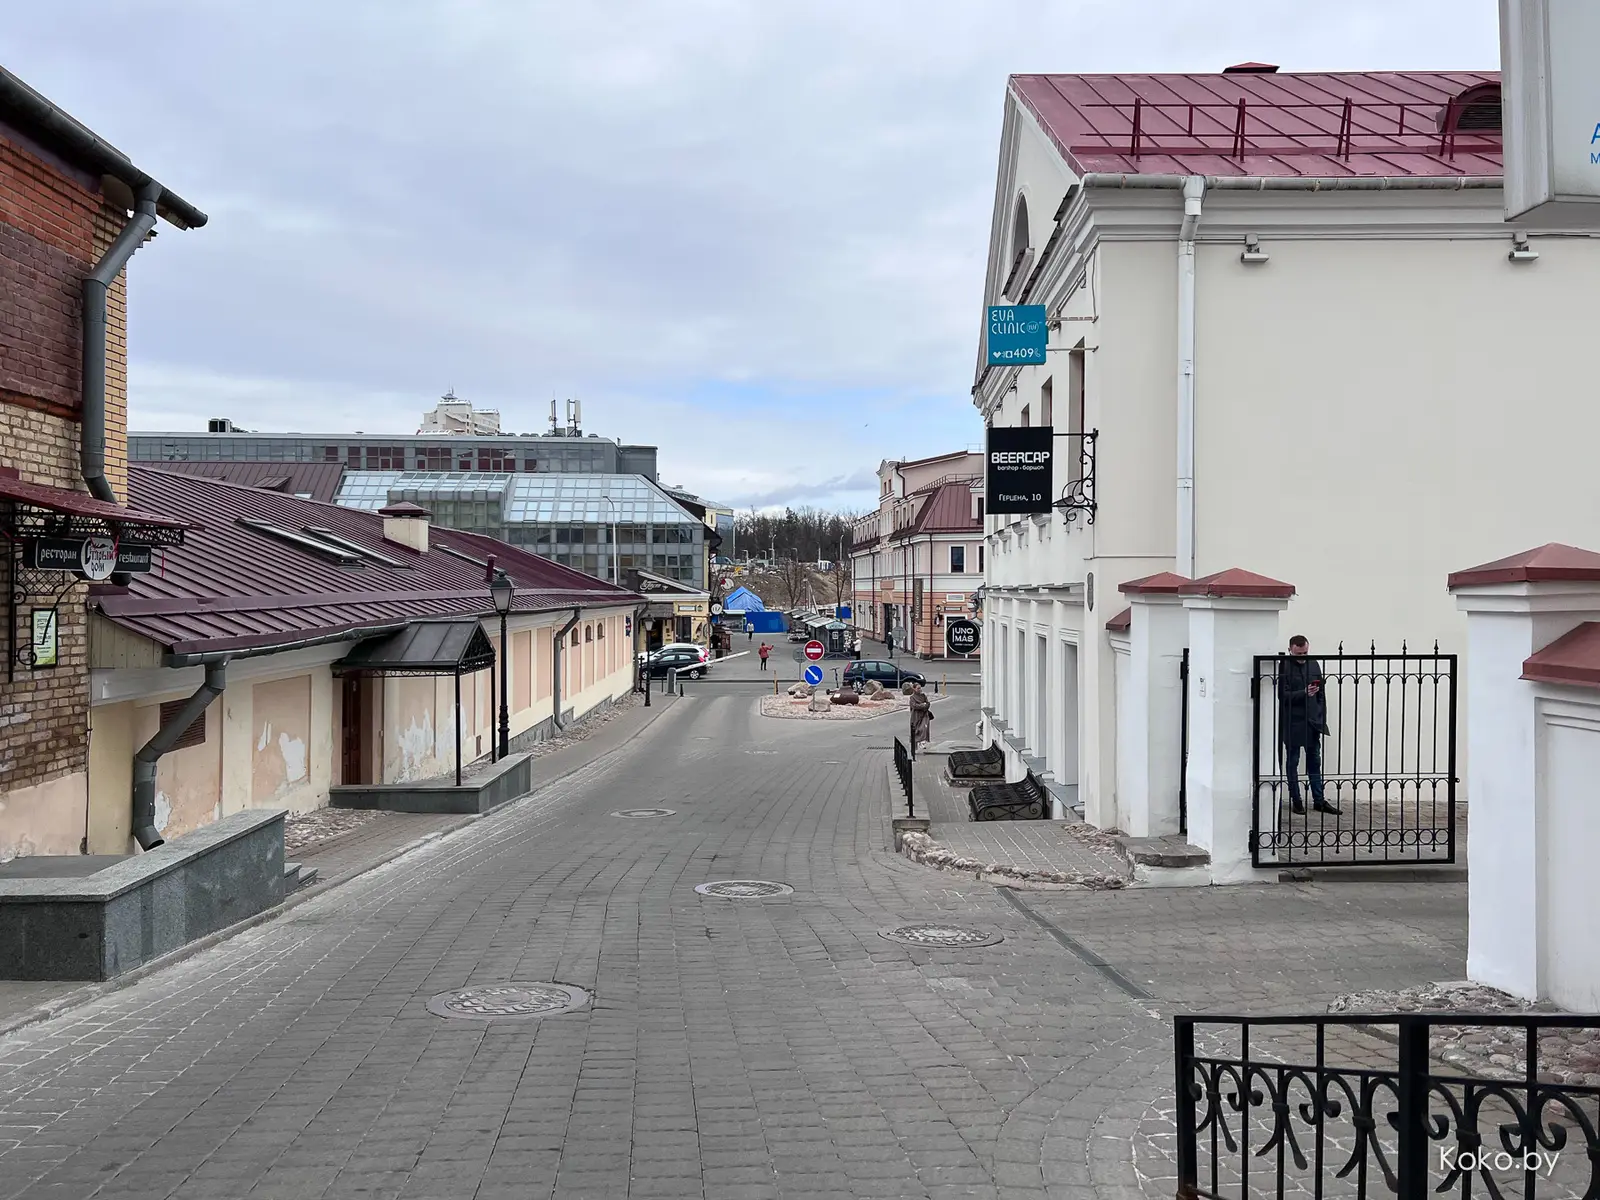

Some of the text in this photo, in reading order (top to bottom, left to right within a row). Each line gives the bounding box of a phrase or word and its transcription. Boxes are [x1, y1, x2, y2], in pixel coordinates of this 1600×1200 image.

[991, 309, 1014, 322] EVA
[991, 322, 1026, 335] CLINIC
[1013, 347, 1034, 358] 409
[991, 451, 1050, 464] BEERCAP
[1032, 493, 1042, 502] 10
